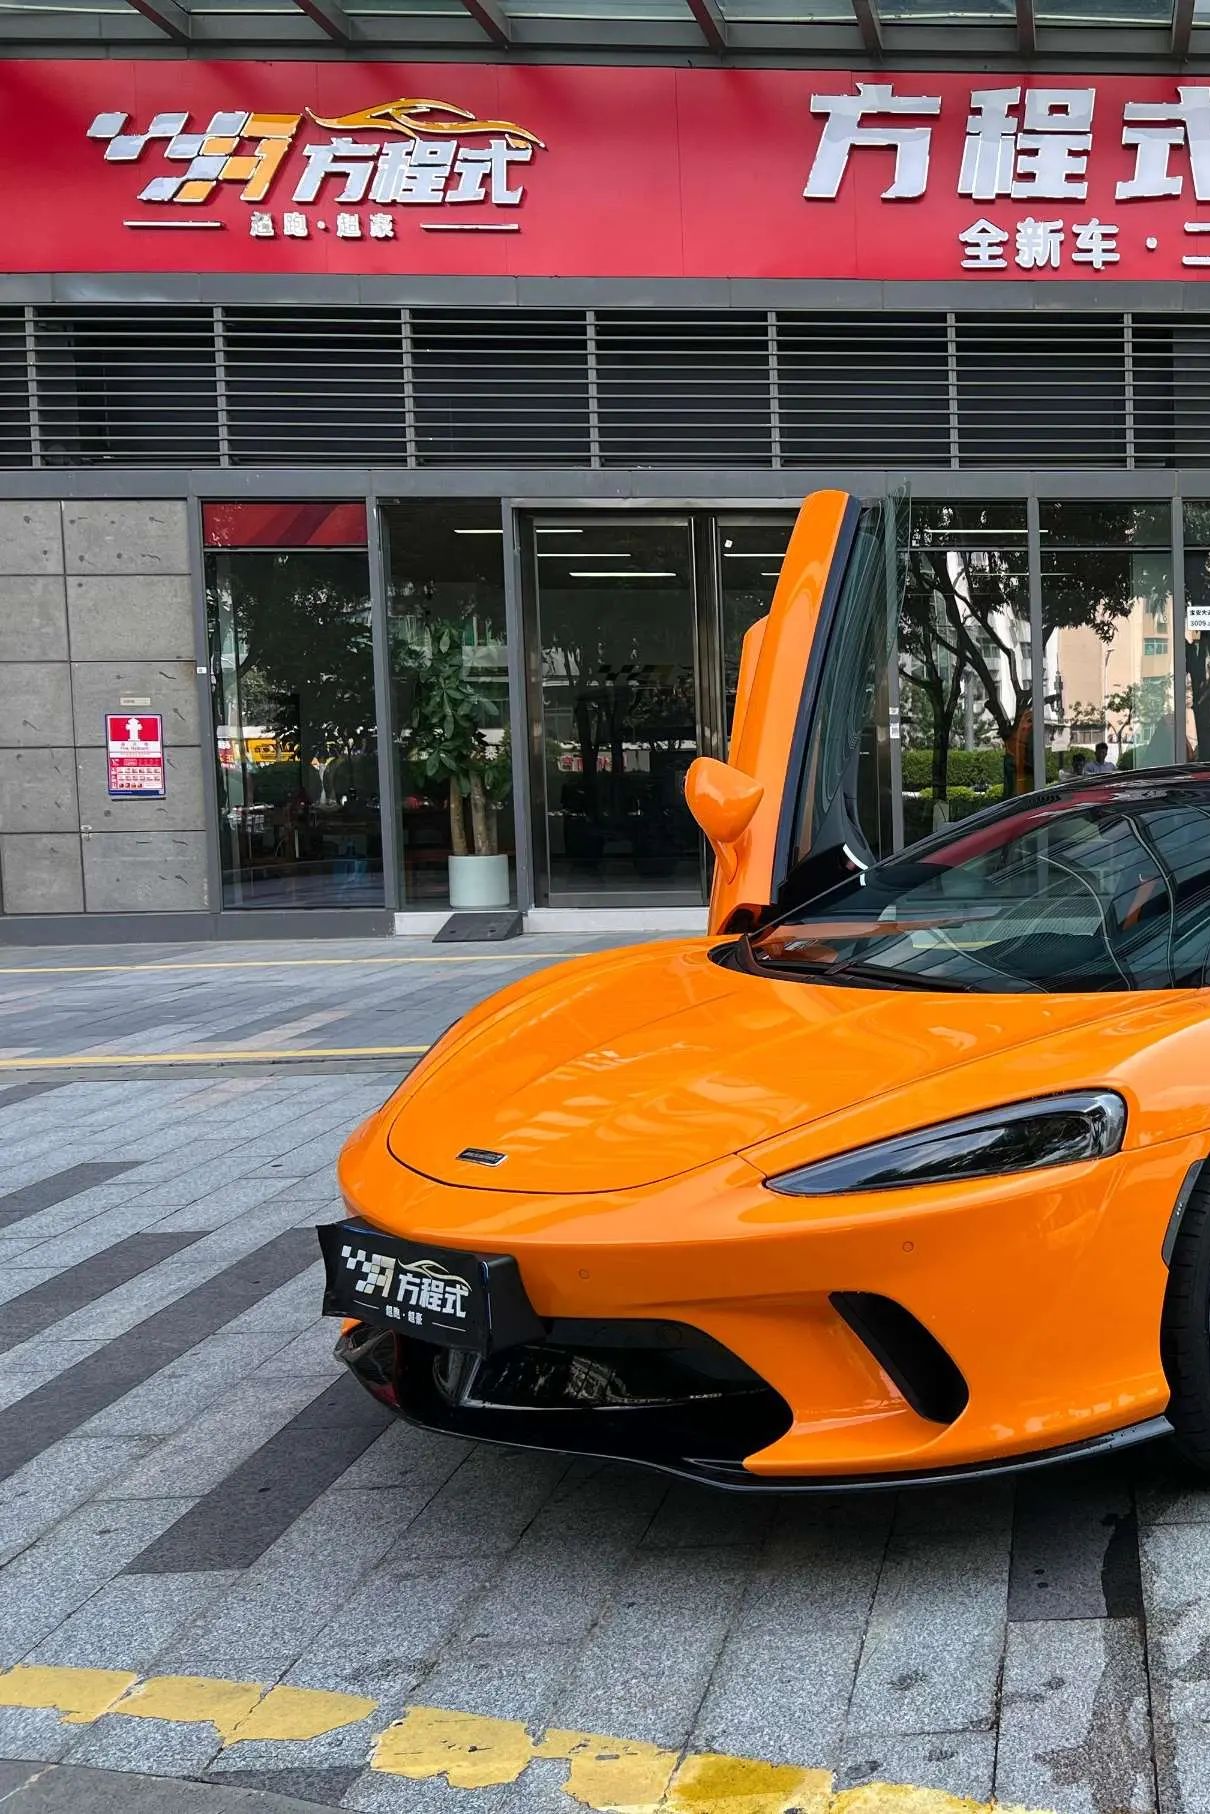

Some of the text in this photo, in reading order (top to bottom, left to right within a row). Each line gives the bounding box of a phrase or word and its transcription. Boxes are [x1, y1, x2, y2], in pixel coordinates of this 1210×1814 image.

[293, 135, 532, 205] 方程式
[397, 1272, 469, 1318] 方程式
